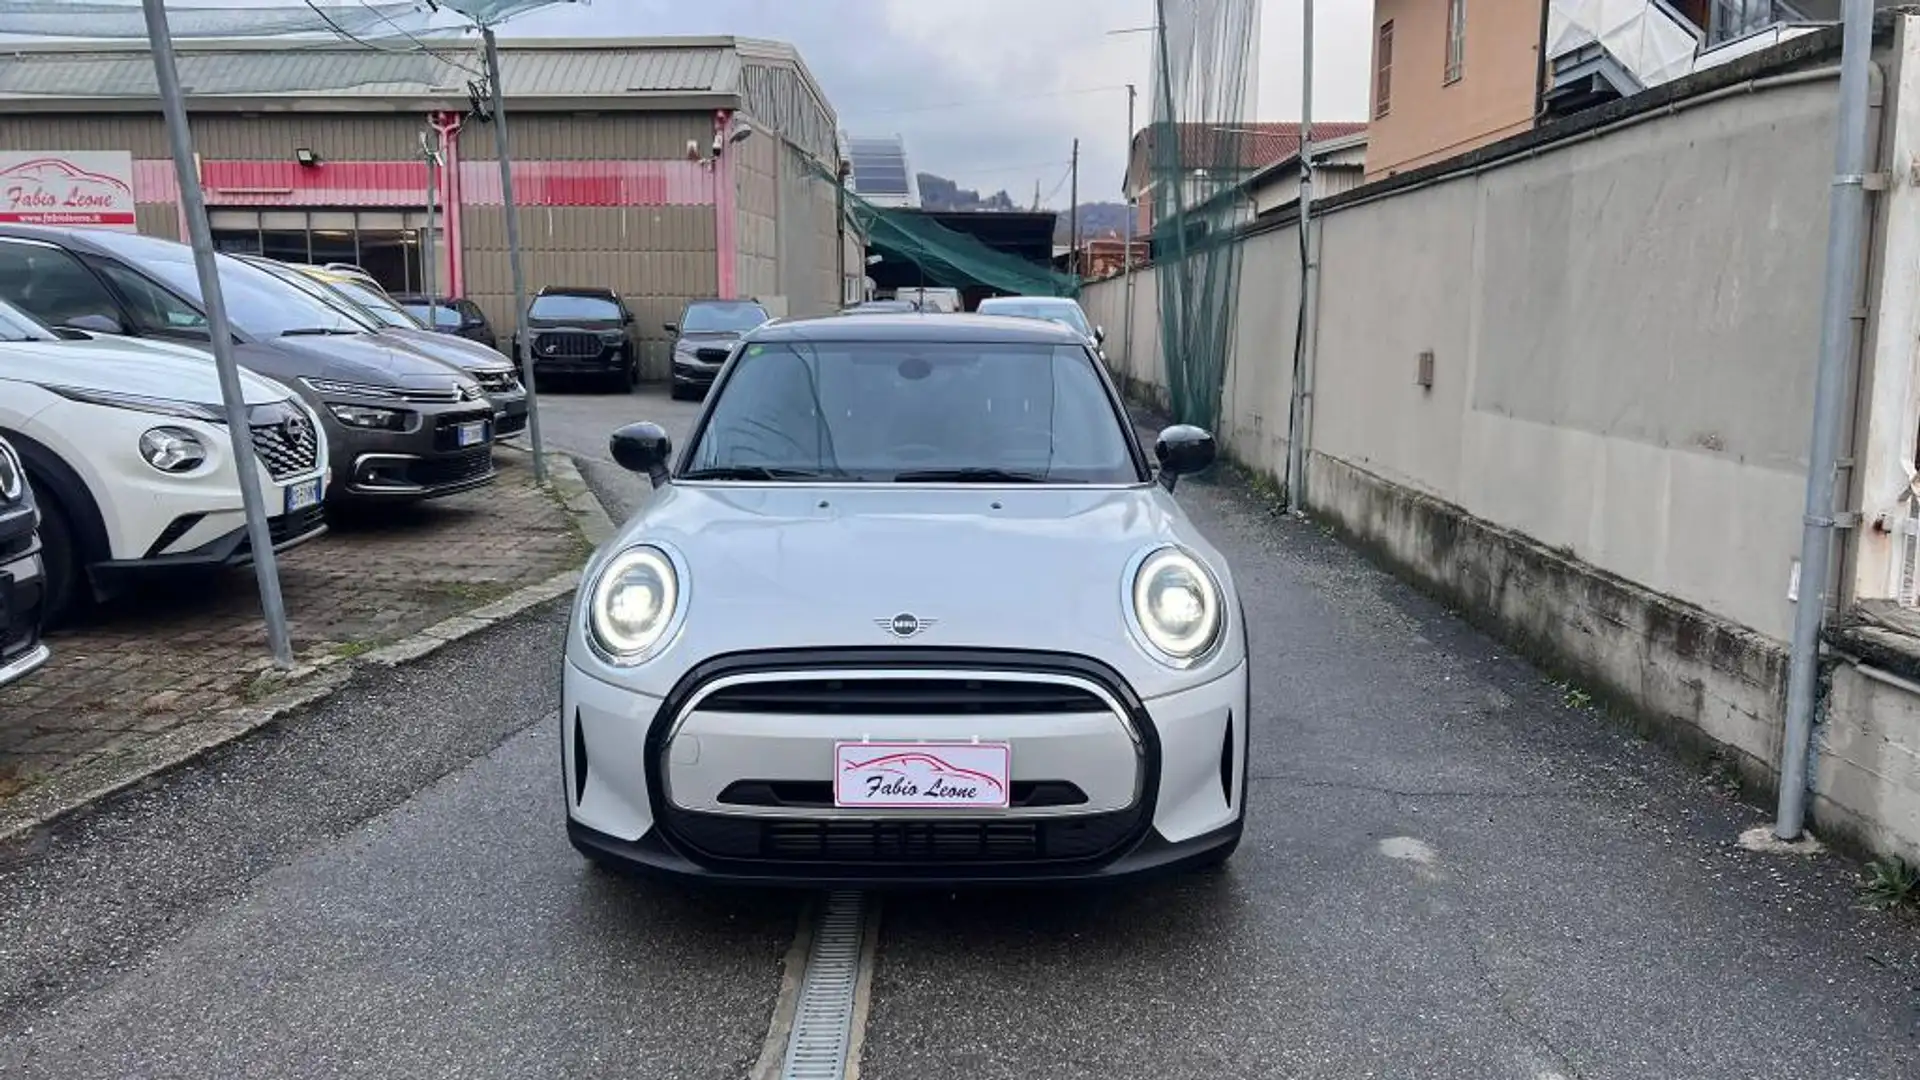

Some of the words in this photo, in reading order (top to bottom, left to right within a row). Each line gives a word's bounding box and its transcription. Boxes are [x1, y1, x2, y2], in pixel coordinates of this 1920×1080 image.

[7, 186, 56, 210] Fabio
[63, 186, 113, 207] Leone
[894, 620, 916, 628] MINI
[866, 776, 919, 798] Fabio
[923, 777, 978, 799] Leone
